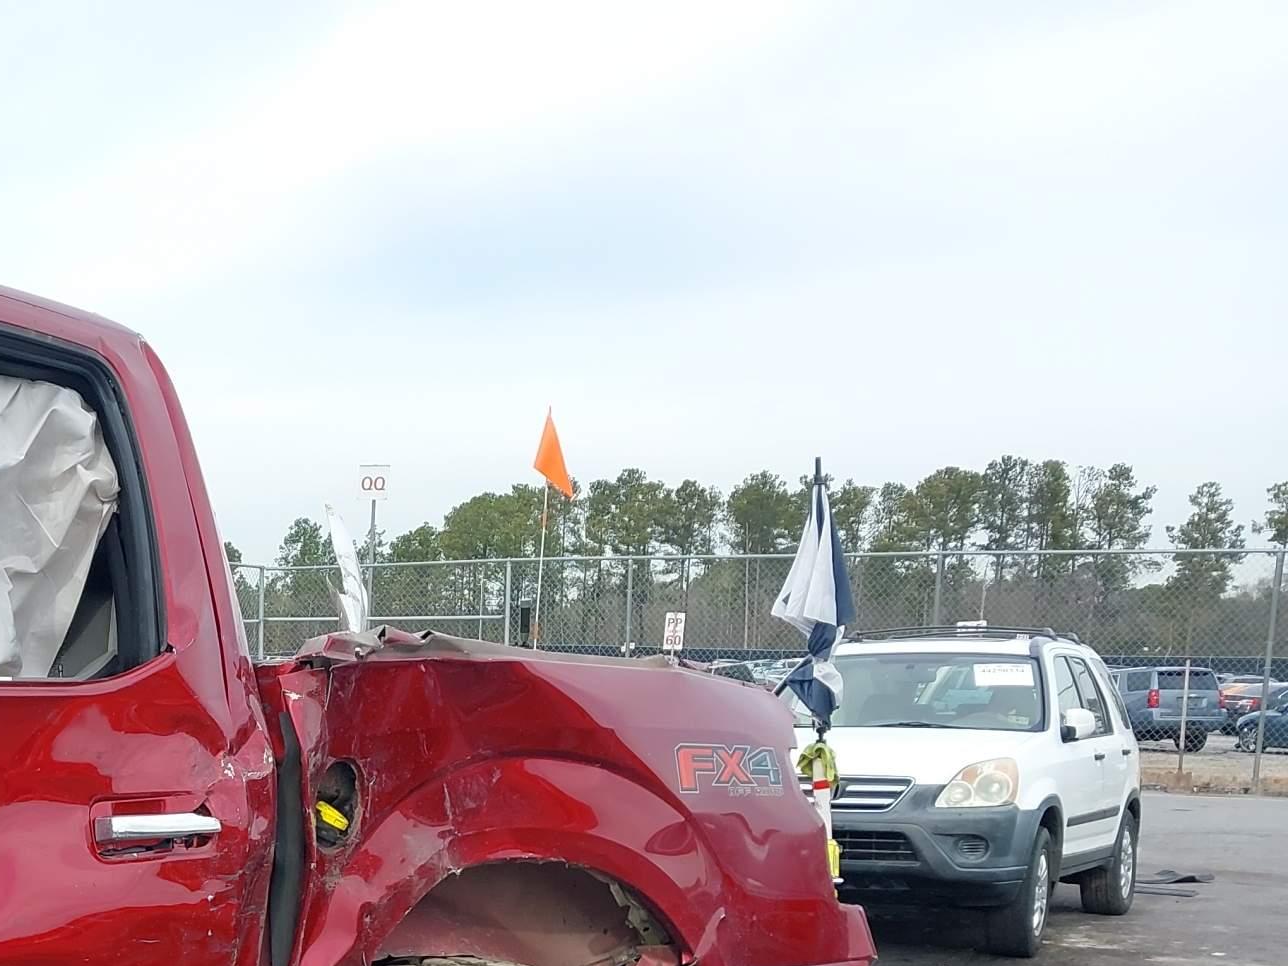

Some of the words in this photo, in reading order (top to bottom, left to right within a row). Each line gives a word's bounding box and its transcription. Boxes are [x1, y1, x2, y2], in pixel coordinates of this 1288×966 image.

[361, 476, 385, 491] QQ
[667, 617, 683, 628] PP
[665, 634, 681, 646] 60
[674, 743, 783, 794] FX4
